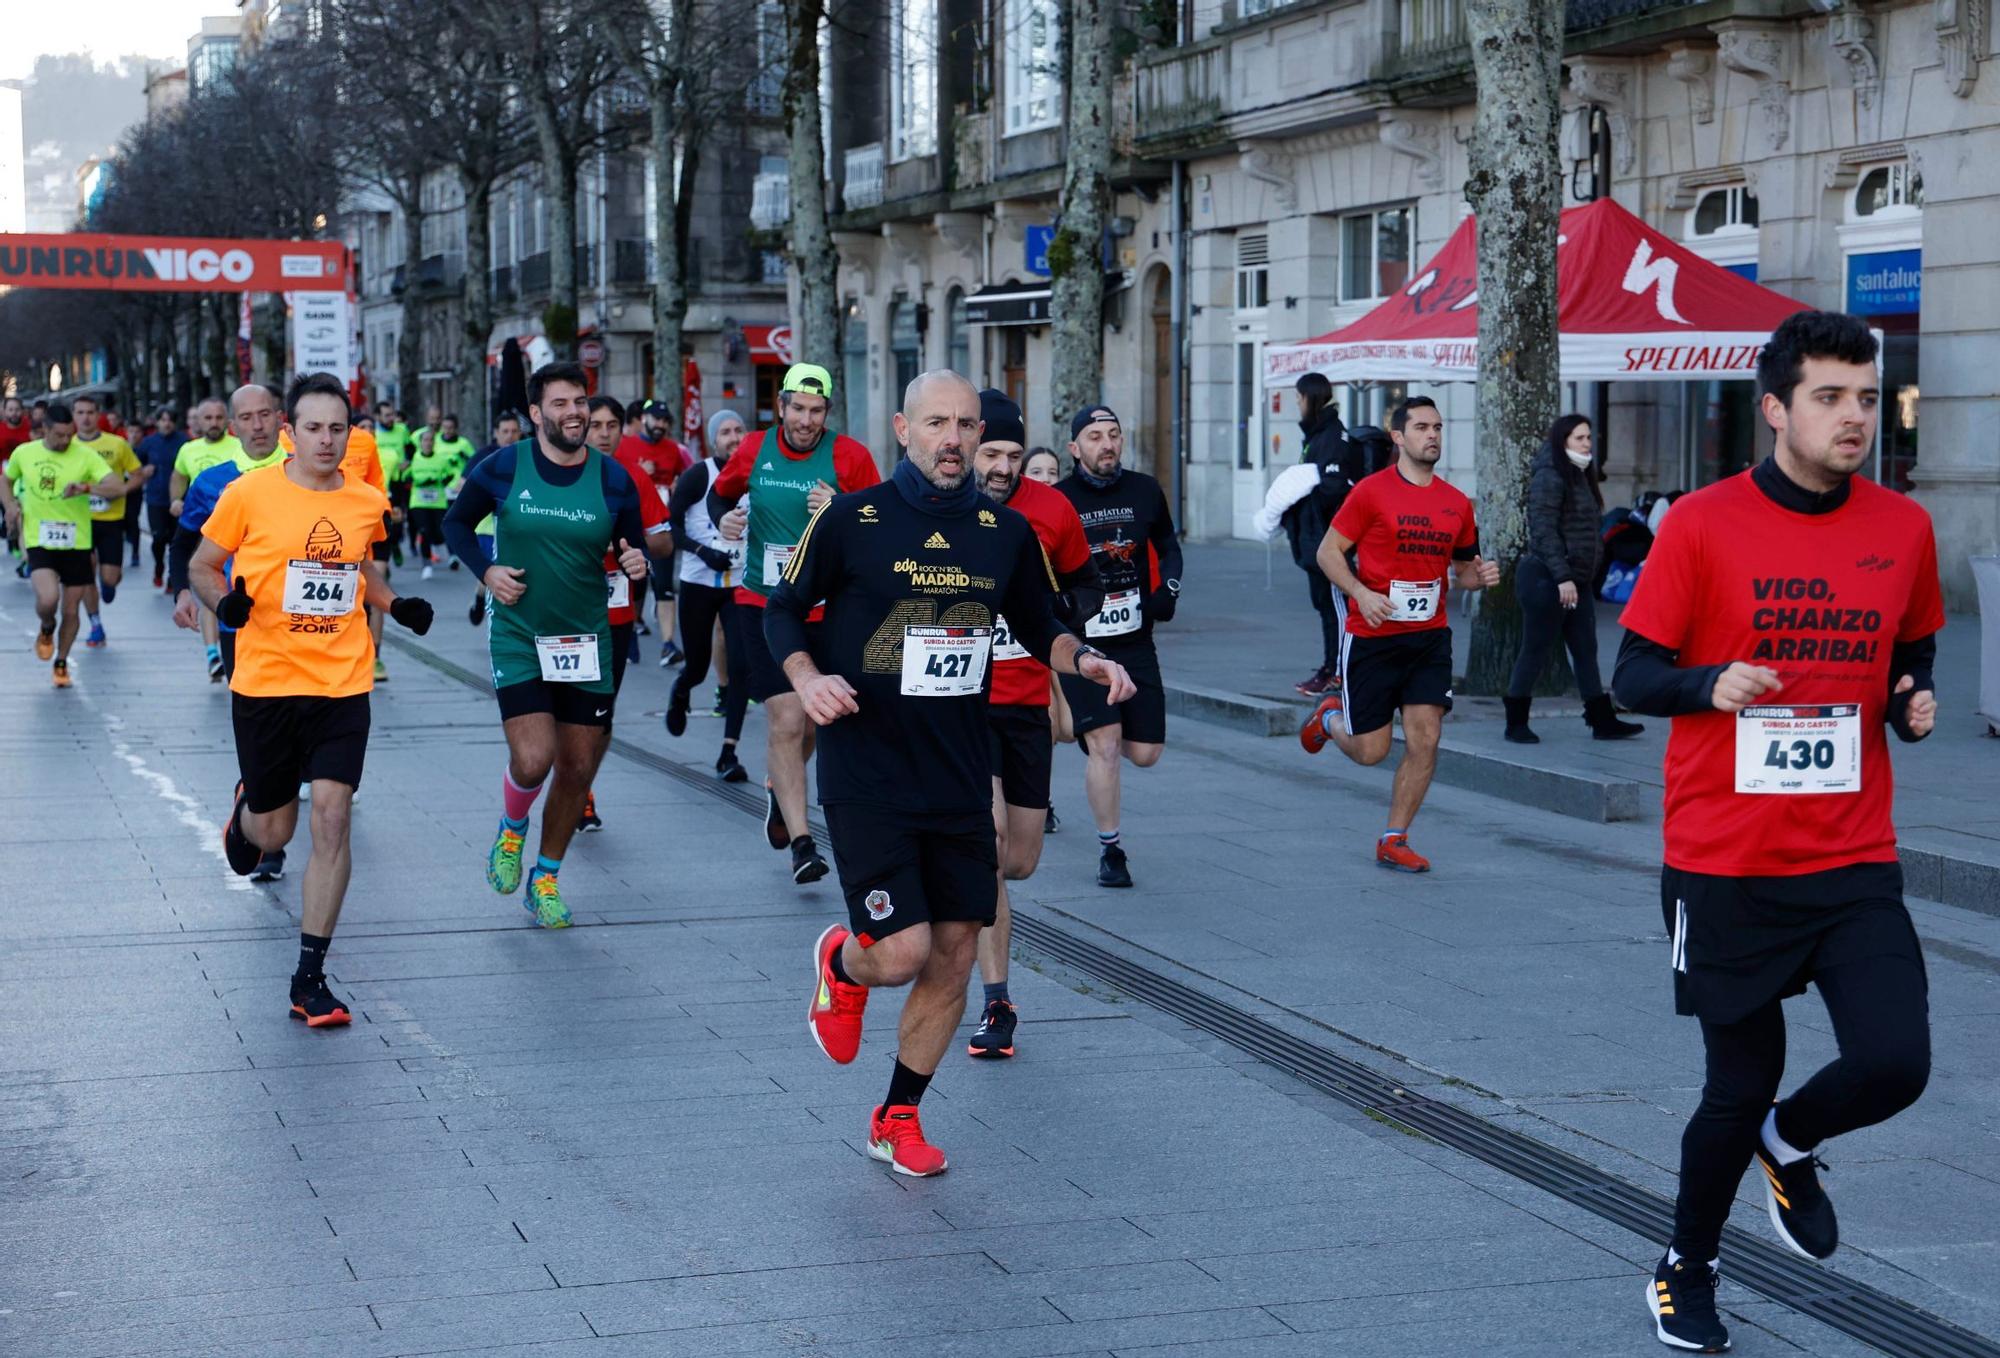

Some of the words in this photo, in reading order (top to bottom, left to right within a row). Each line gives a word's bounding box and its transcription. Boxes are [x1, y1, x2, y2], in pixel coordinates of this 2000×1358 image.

[924, 541, 950, 549] adidas
[893, 557, 918, 575] edp
[912, 573, 970, 587] MADRID
[302, 581, 344, 601] 264
[923, 586, 958, 595] MARATÓN
[1752, 578, 1836, 602] VIGO,
[1407, 598, 1428, 611] 92
[1099, 607, 1130, 624] 400
[1752, 608, 1882, 632] CHANZO
[289, 623, 341, 634] ZONE
[1751, 638, 1878, 663] ARRIBA!
[552, 654, 581, 670] 127
[925, 654, 973, 678] 427
[1762, 721, 1792, 729] SUBIDA
[1794, 721, 1805, 729] AO
[1807, 720, 1839, 729] CASTRO
[1764, 739, 1835, 771] 430
